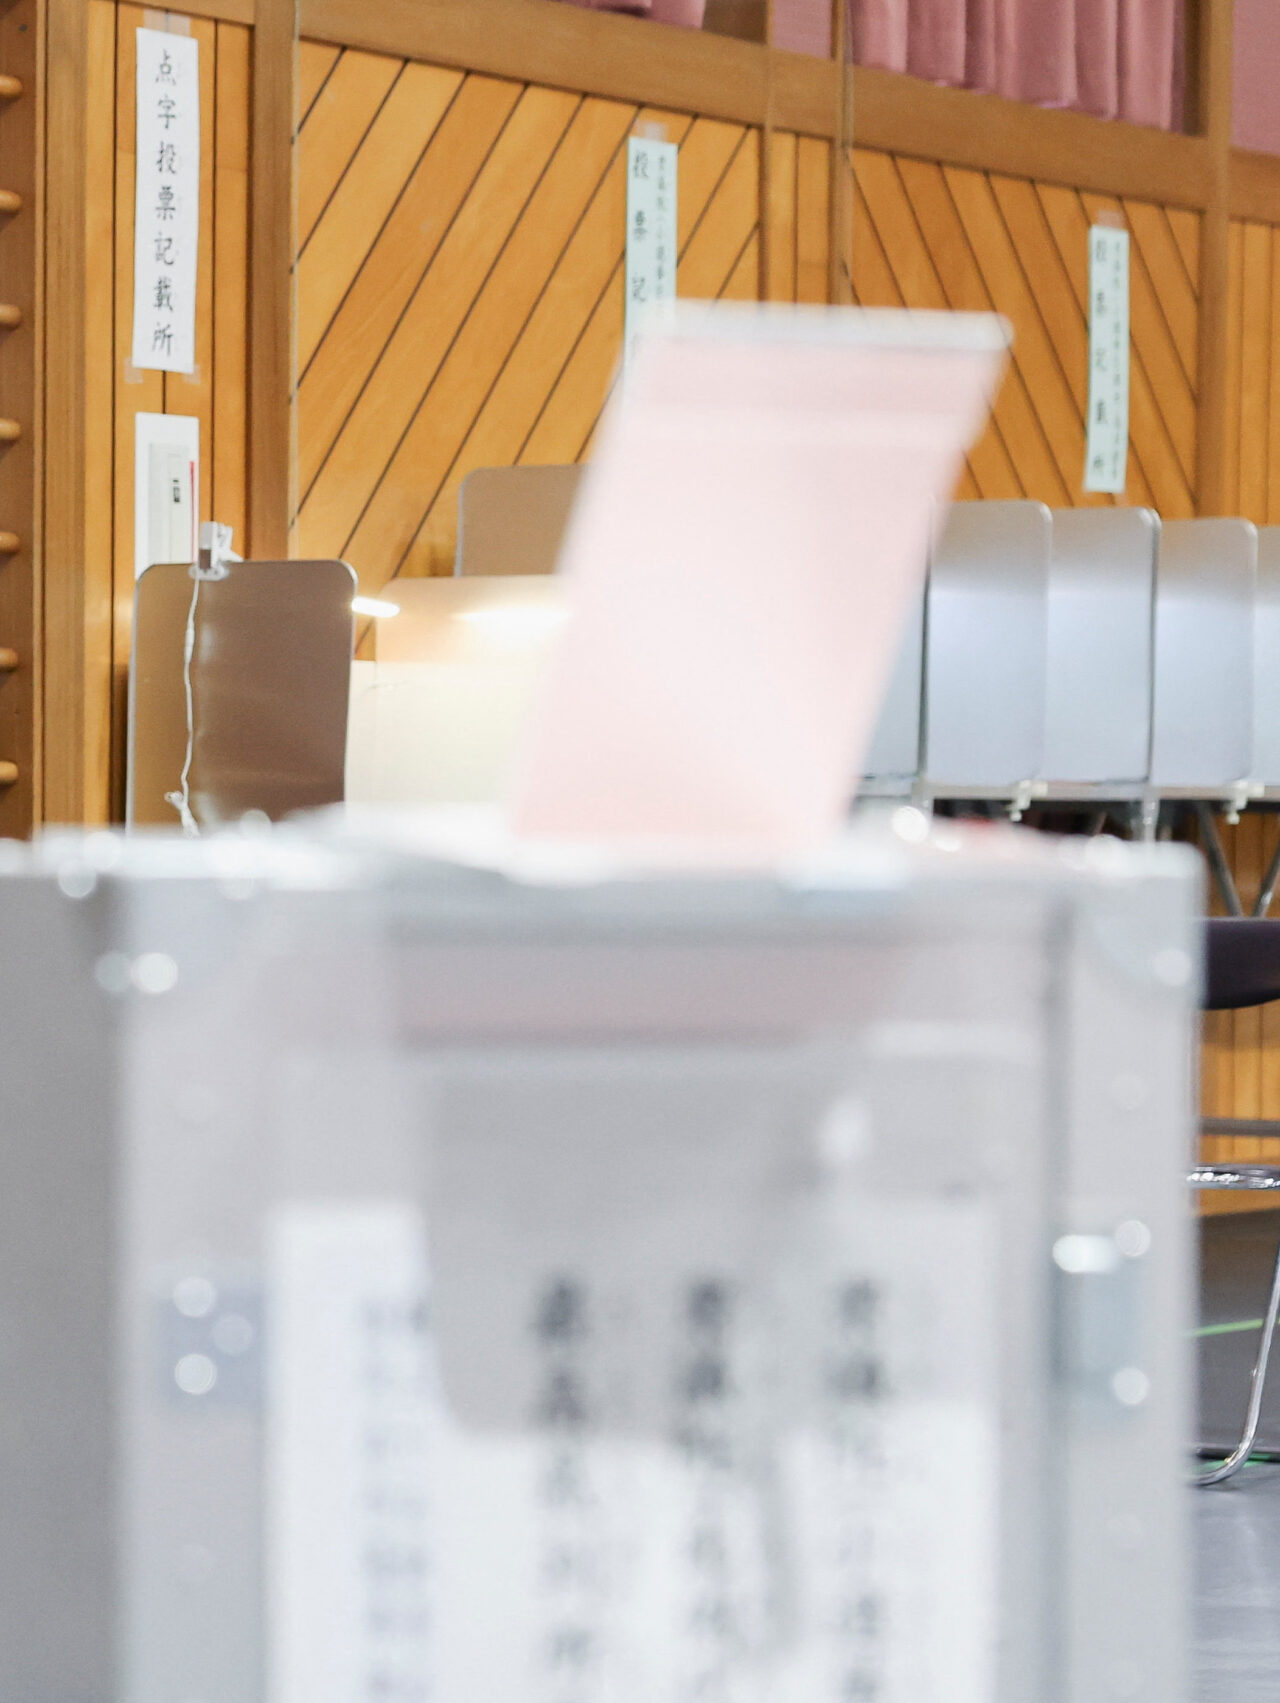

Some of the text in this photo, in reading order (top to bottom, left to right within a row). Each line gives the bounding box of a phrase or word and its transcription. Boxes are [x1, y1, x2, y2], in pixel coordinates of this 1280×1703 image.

[152, 49, 176, 357] 点字投票記載所
